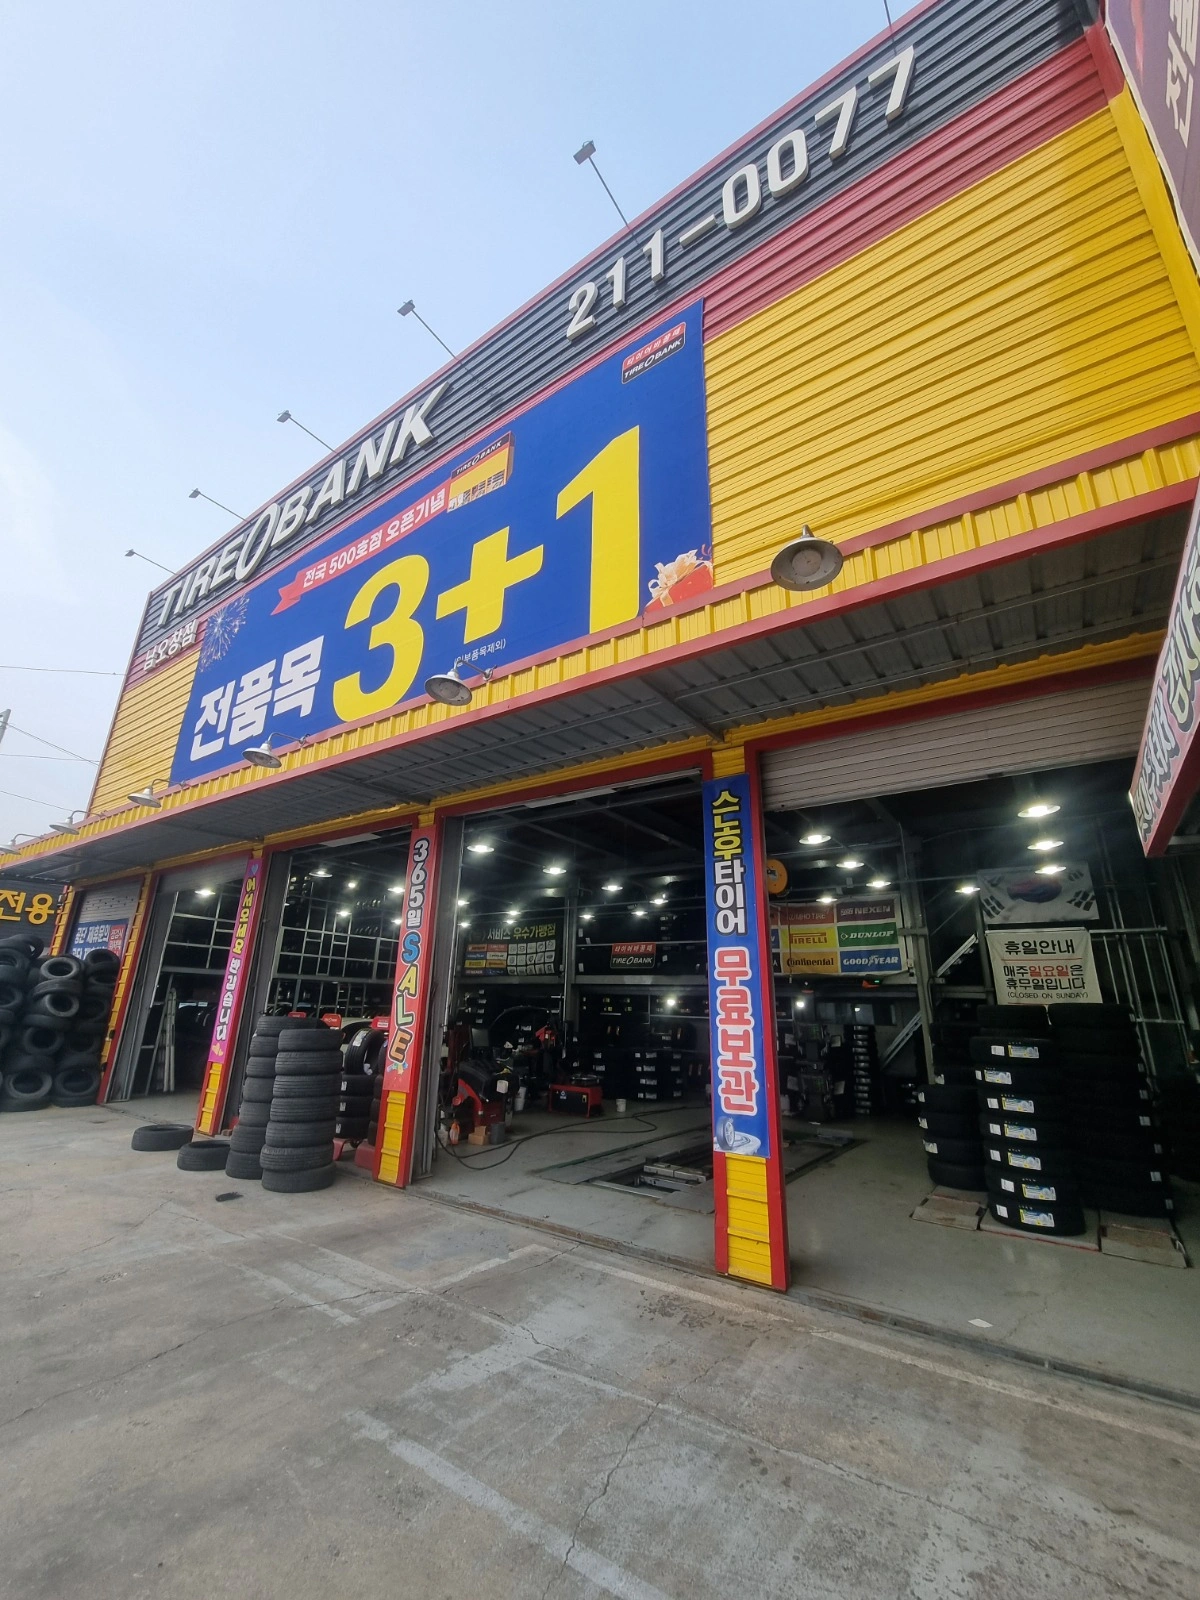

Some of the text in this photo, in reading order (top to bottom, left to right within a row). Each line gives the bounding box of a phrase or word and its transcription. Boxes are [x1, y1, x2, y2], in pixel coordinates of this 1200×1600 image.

[567, 45, 915, 340] 211-0077
[303, 488, 446, 588] 전국 500호점 오픈기념
[190, 425, 640, 762] 전품목 3+1
[143, 619, 199, 673] 남오창점
[0, 889, 55, 925] 전용
[854, 905, 891, 915] NEXEN
[487, 928, 511, 941] 서비스
[513, 923, 556, 939] 우수가맹점
[789, 932, 828, 944] PIRELLI
[849, 930, 894, 939] DUNLOP
[216, 877, 256, 1041] 어서오세요 반갑습니다
[389, 837, 430, 1063] 365일 SALE
[711, 789, 757, 1116] 스노우타이어 무료보관
[1004, 939, 1075, 955] 휴일안내
[787, 957, 834, 967] Continental
[1005, 977, 1086, 991] 휴무일입니다
[1007, 991, 1089, 999] (CLOSED ON SUNDAY)
